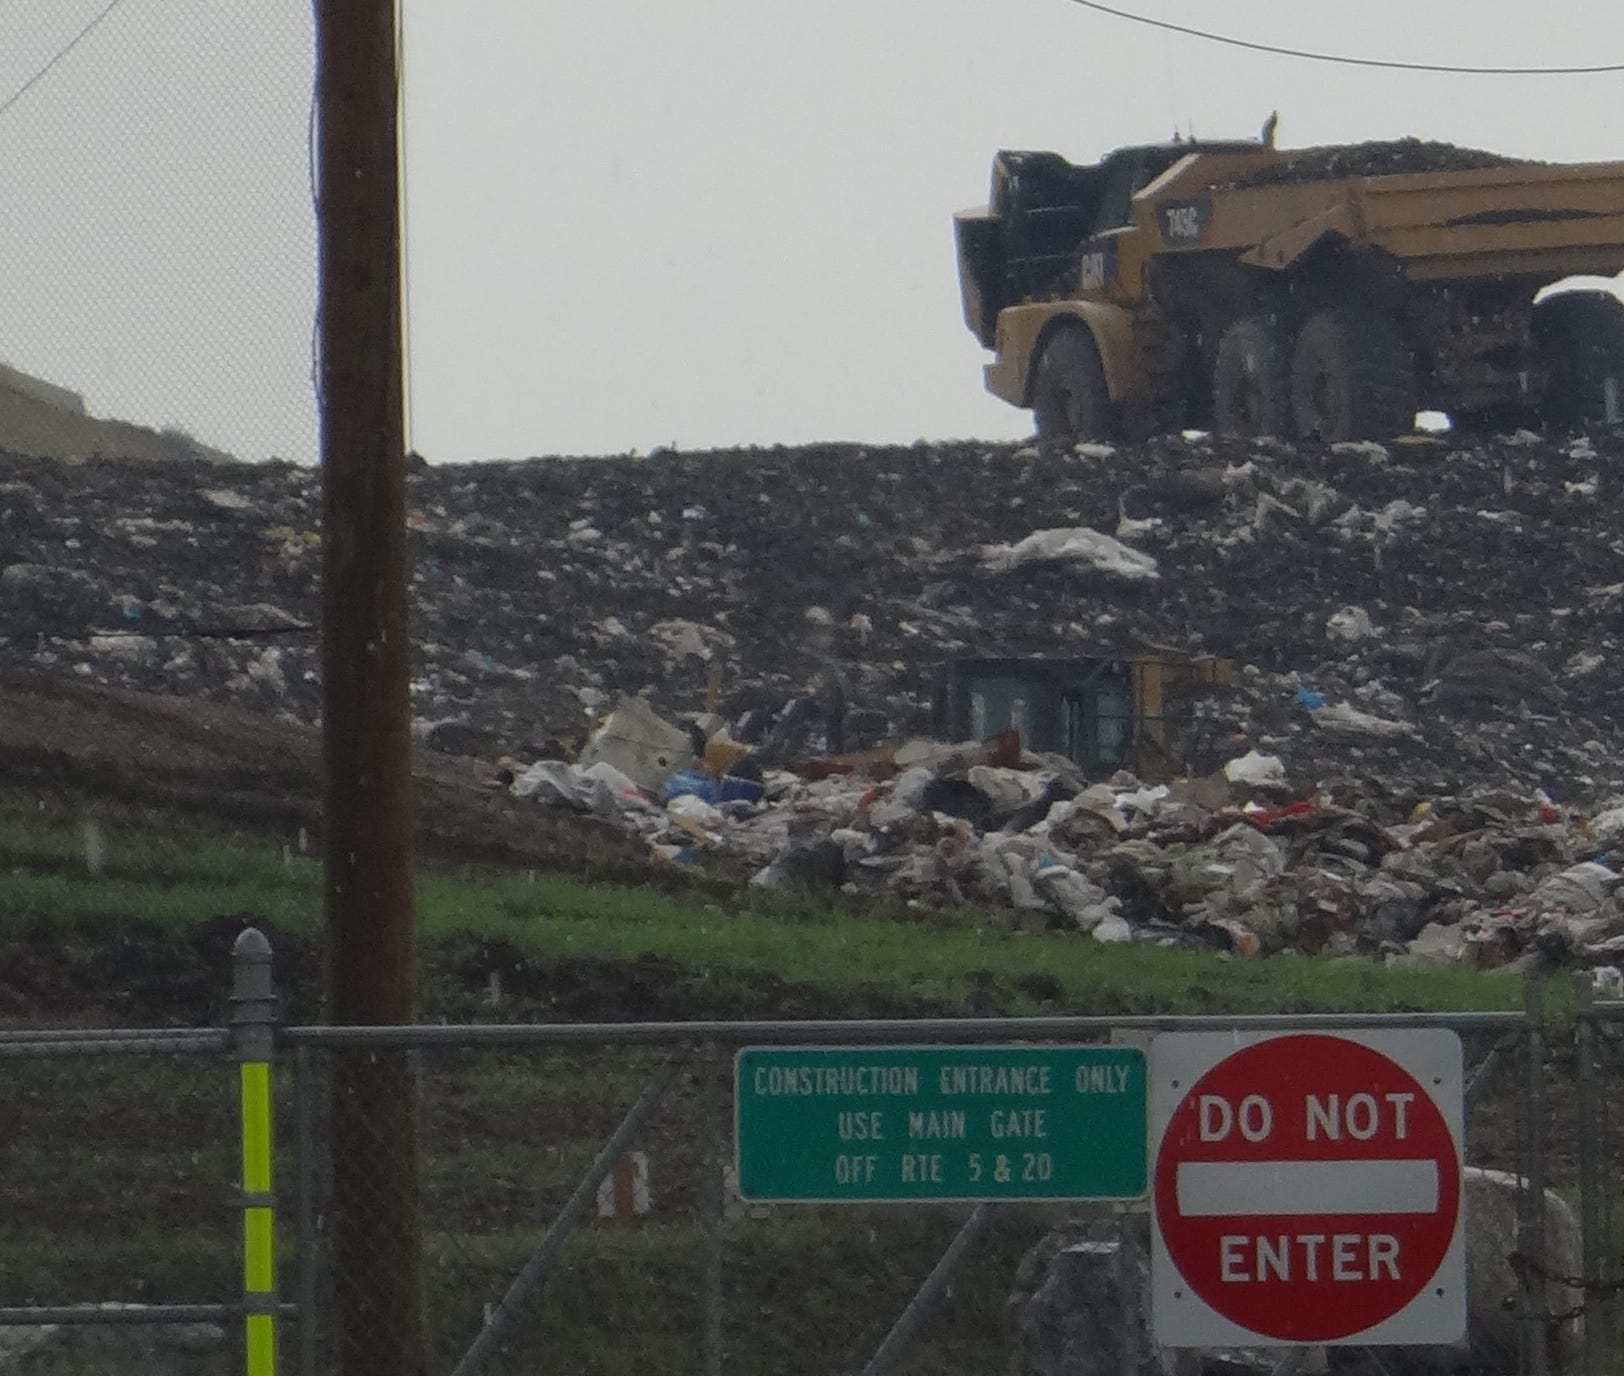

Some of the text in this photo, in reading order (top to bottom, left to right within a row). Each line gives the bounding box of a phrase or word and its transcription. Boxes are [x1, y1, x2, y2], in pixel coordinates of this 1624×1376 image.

[754, 1064, 1130, 1096] CONSTRUCTION ENTRANCE ONLY
[837, 1109, 1048, 1140] USE MAIN GATE
[1199, 1092, 1415, 1142] DO NOT
[834, 1153, 1053, 1183] OFF RTE 5 & 20
[1220, 1234, 1401, 1283] ENTER
